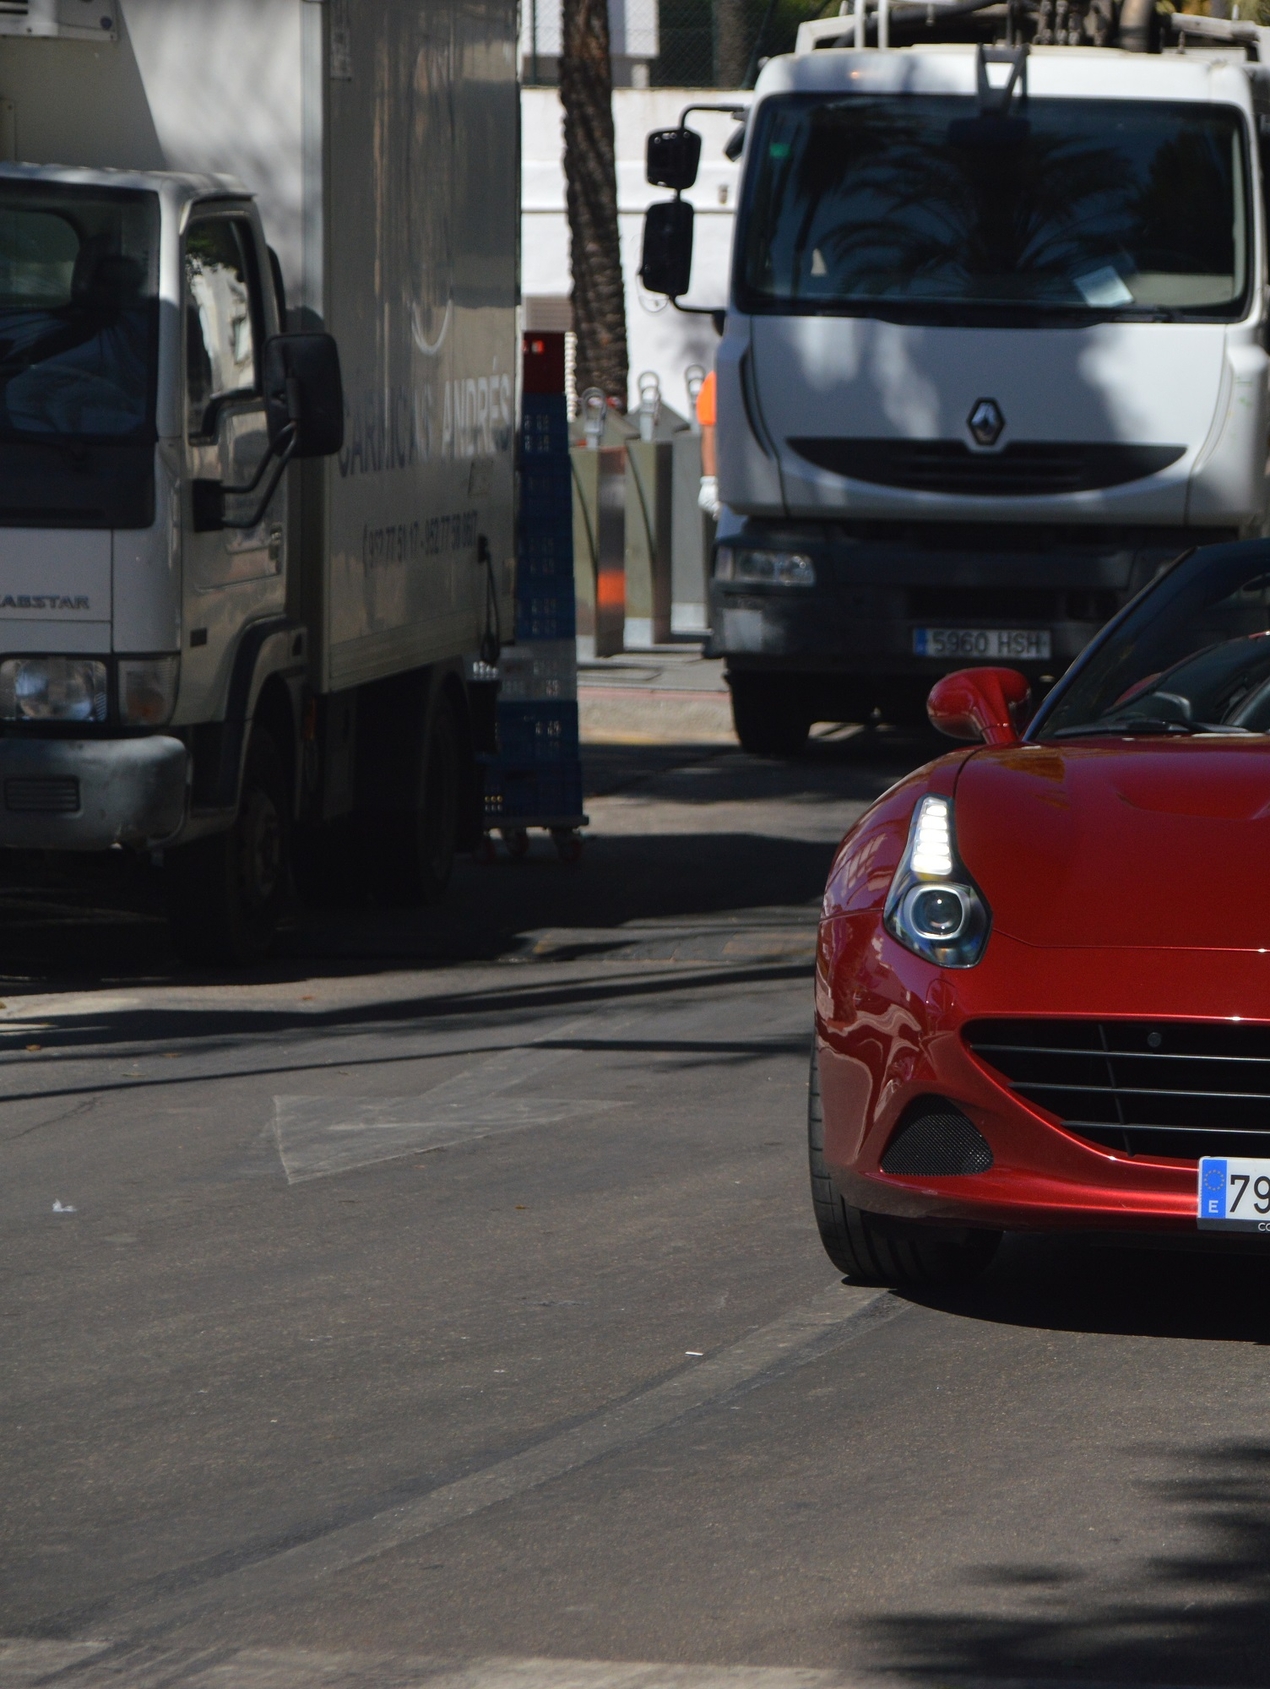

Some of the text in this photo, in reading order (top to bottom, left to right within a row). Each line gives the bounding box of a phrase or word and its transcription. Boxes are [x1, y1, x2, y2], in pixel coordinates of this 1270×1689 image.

[932, 630, 1041, 653] 5960 HSH
[1208, 1200, 1219, 1213] E
